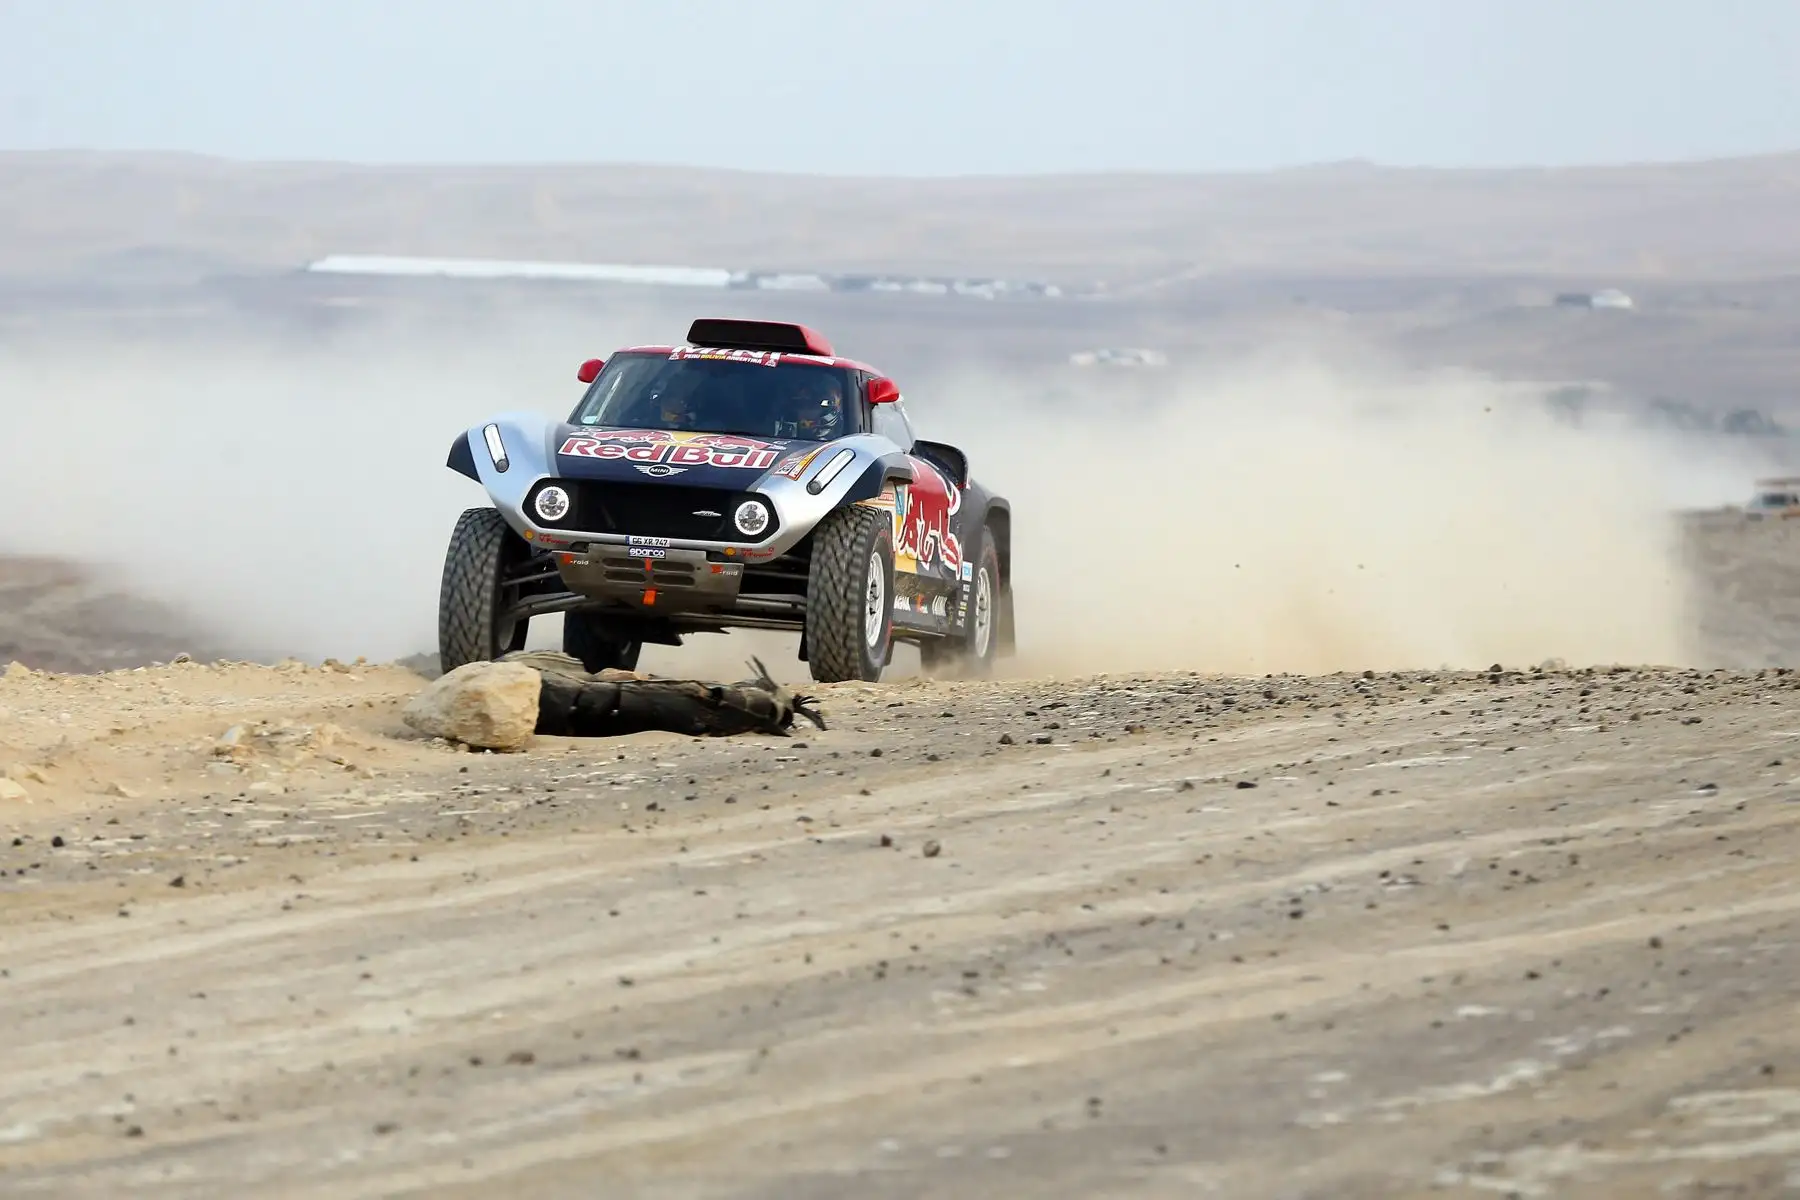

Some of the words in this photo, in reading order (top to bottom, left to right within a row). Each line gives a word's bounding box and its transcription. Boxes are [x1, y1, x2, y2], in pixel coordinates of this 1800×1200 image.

[726, 355, 762, 364] ARGENTINA
[558, 438, 667, 463] Red
[666, 444, 779, 469] Bull
[629, 548, 665, 557] sparco
